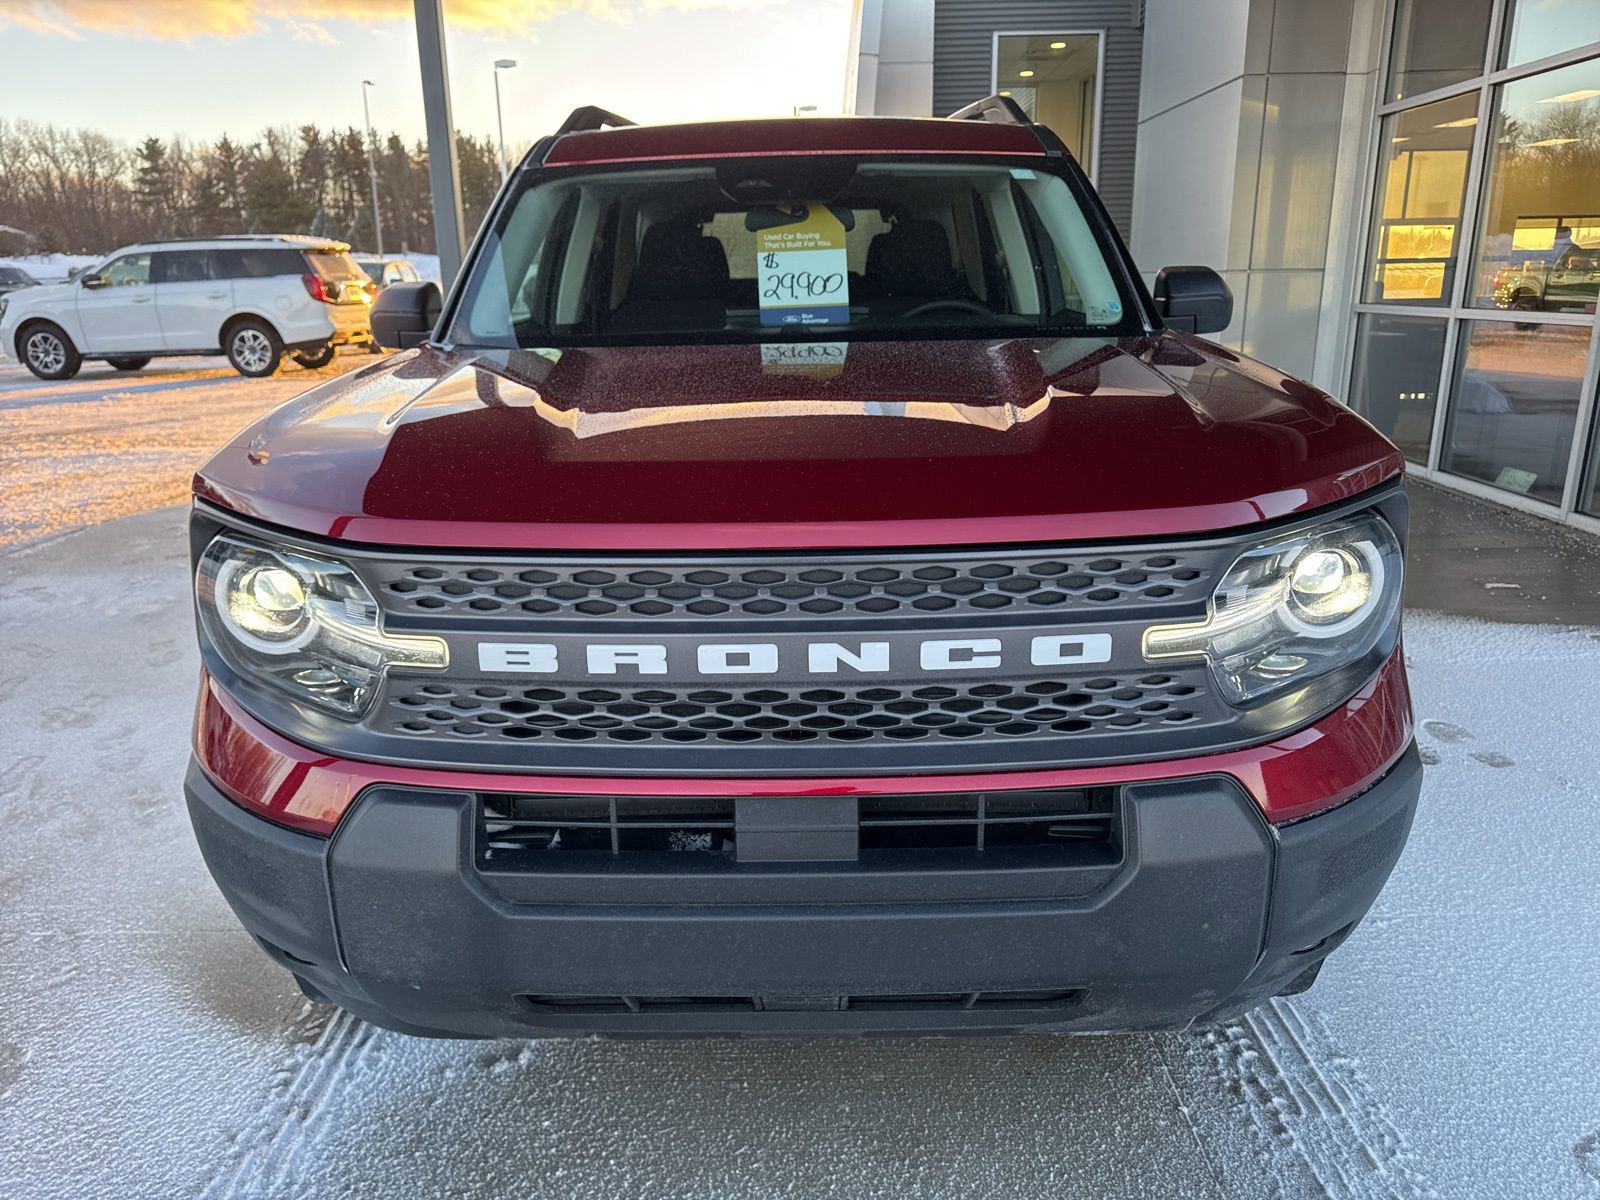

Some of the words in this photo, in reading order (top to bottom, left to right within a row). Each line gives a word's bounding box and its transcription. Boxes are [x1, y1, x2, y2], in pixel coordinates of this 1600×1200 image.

[764, 233, 782, 241] Used
[783, 232, 795, 240] Car
[796, 232, 820, 241] Buying
[786, 240, 802, 248] Built
[804, 240, 816, 248] For
[763, 252, 779, 269] $
[478, 633, 1112, 674] BRONCO
